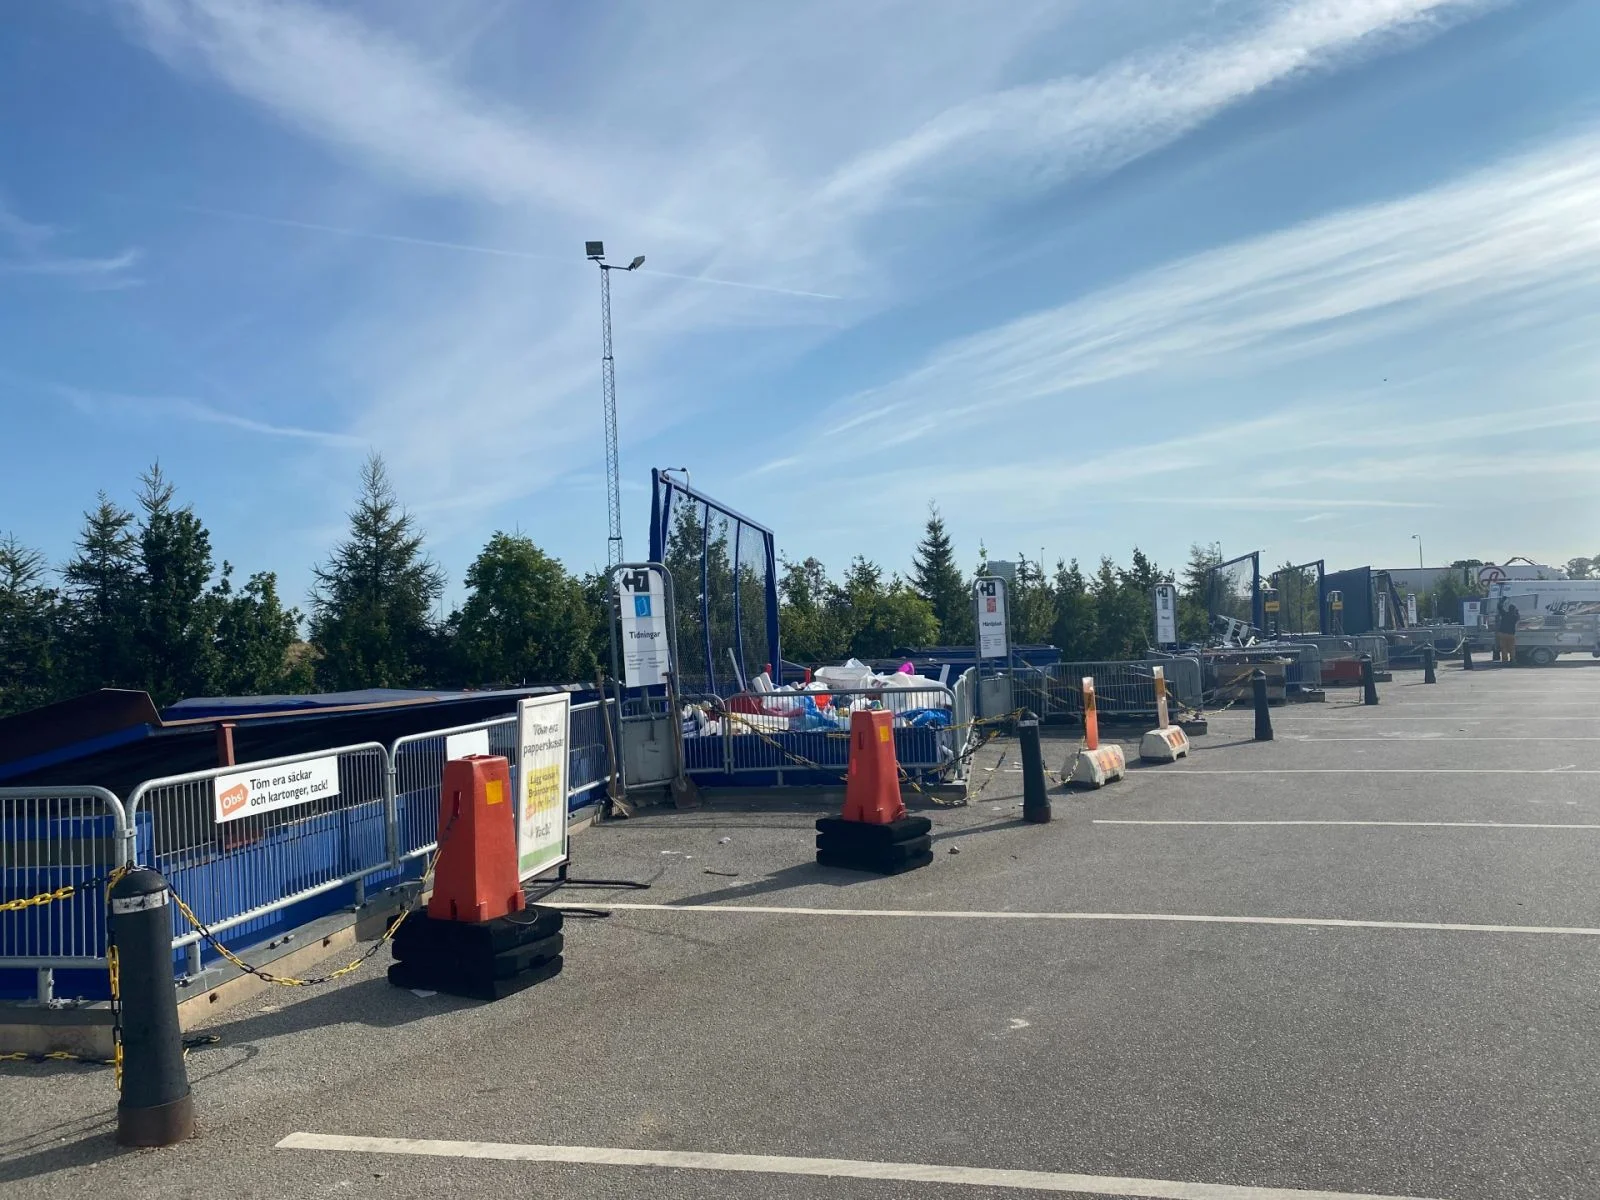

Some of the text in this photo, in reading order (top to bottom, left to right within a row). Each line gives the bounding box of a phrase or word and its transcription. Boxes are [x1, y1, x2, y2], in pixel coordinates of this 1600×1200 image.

[638, 576, 644, 588] 7
[629, 629, 661, 640] Tidningar
[250, 770, 312, 790] Töm era säckar
[222, 789, 244, 809] Obs!
[250, 779, 328, 806] och kartonger, tack!
